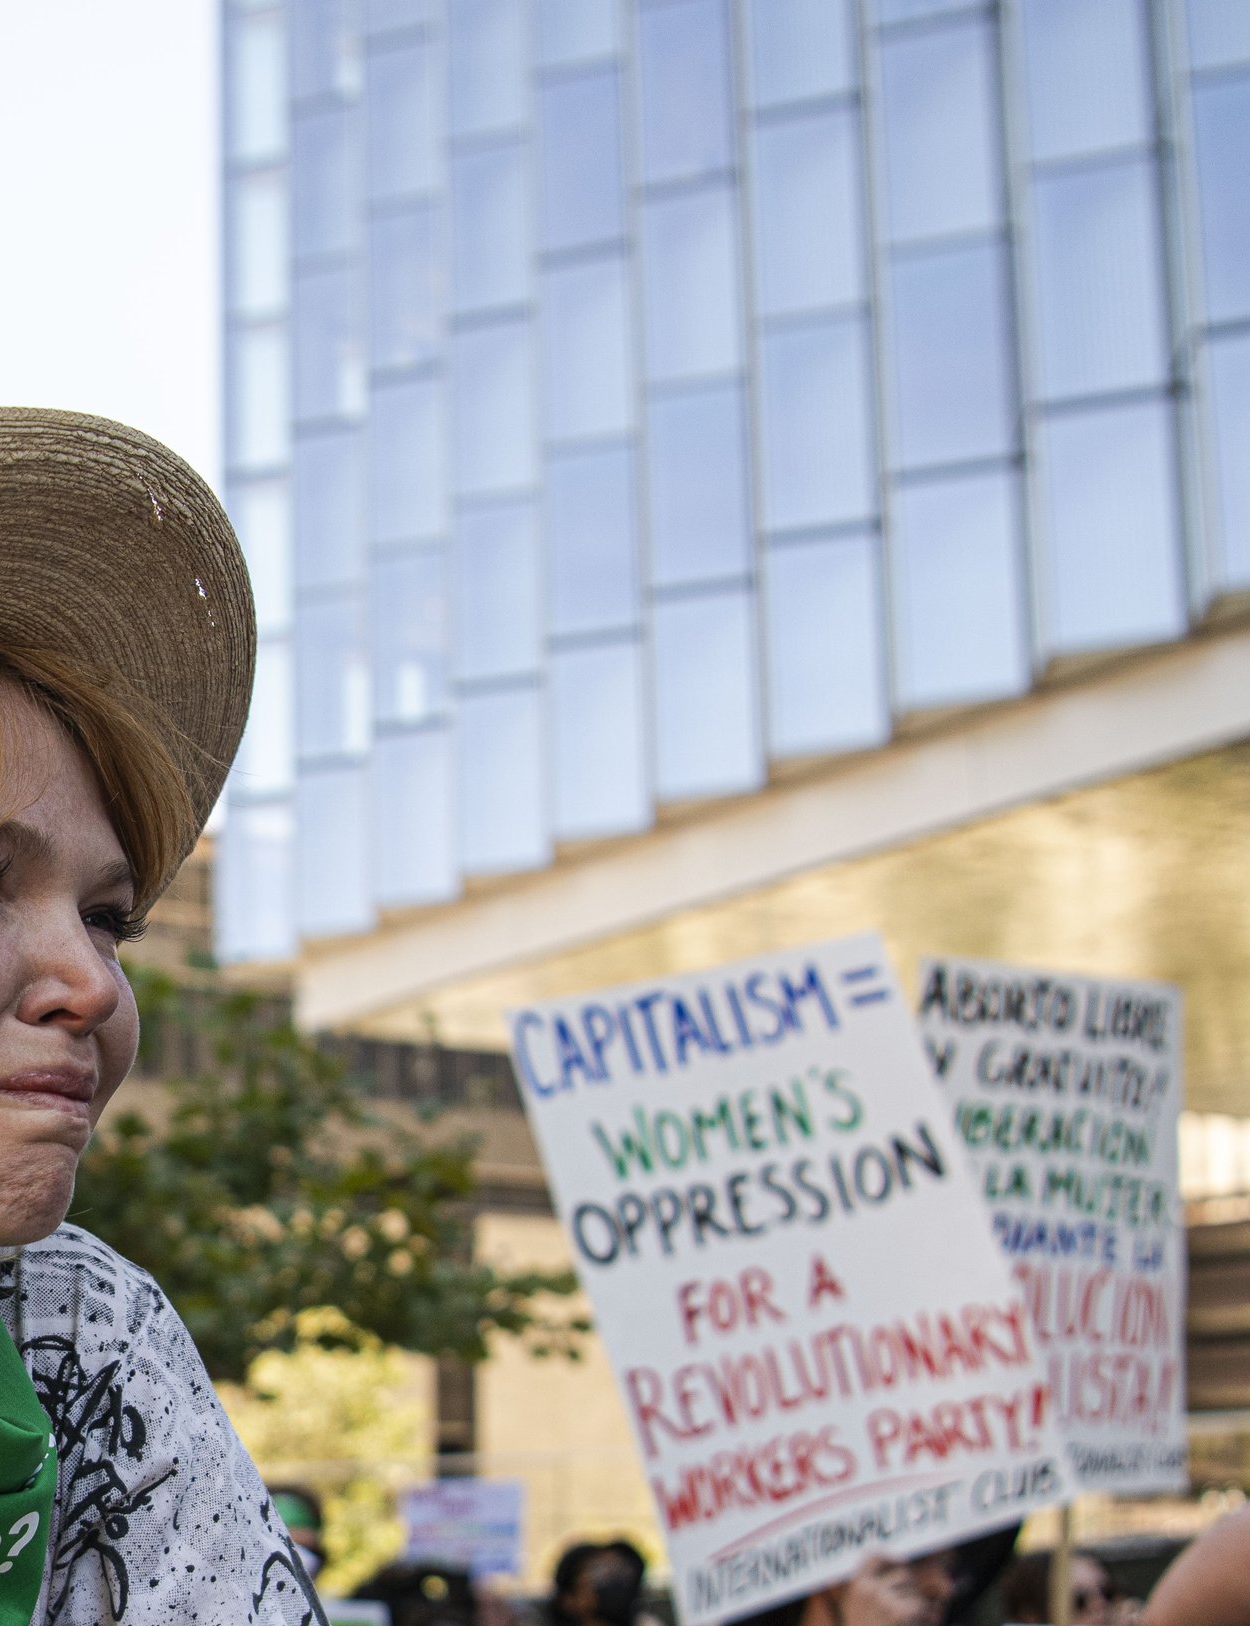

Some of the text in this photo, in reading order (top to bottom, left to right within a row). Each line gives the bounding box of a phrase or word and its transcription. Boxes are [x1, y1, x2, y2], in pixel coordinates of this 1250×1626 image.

[512, 962, 892, 1098] CAPITALISM =
[918, 963, 1168, 1053] ABORTO LIBRE
[590, 1064, 864, 1180] WOMEN'S
[572, 1121, 945, 1266] OPPRESSION
[983, 1158, 1170, 1229] LA MUJER
[677, 1252, 846, 1346] FOR A
[624, 1298, 1029, 1460] REVOLUTIONARY
[652, 1423, 858, 1532] WORKERS
[866, 1383, 1047, 1469] PARTY!
[688, 1479, 964, 1616] INTERNATIONALIST
[969, 1456, 1061, 1514] CLUB
